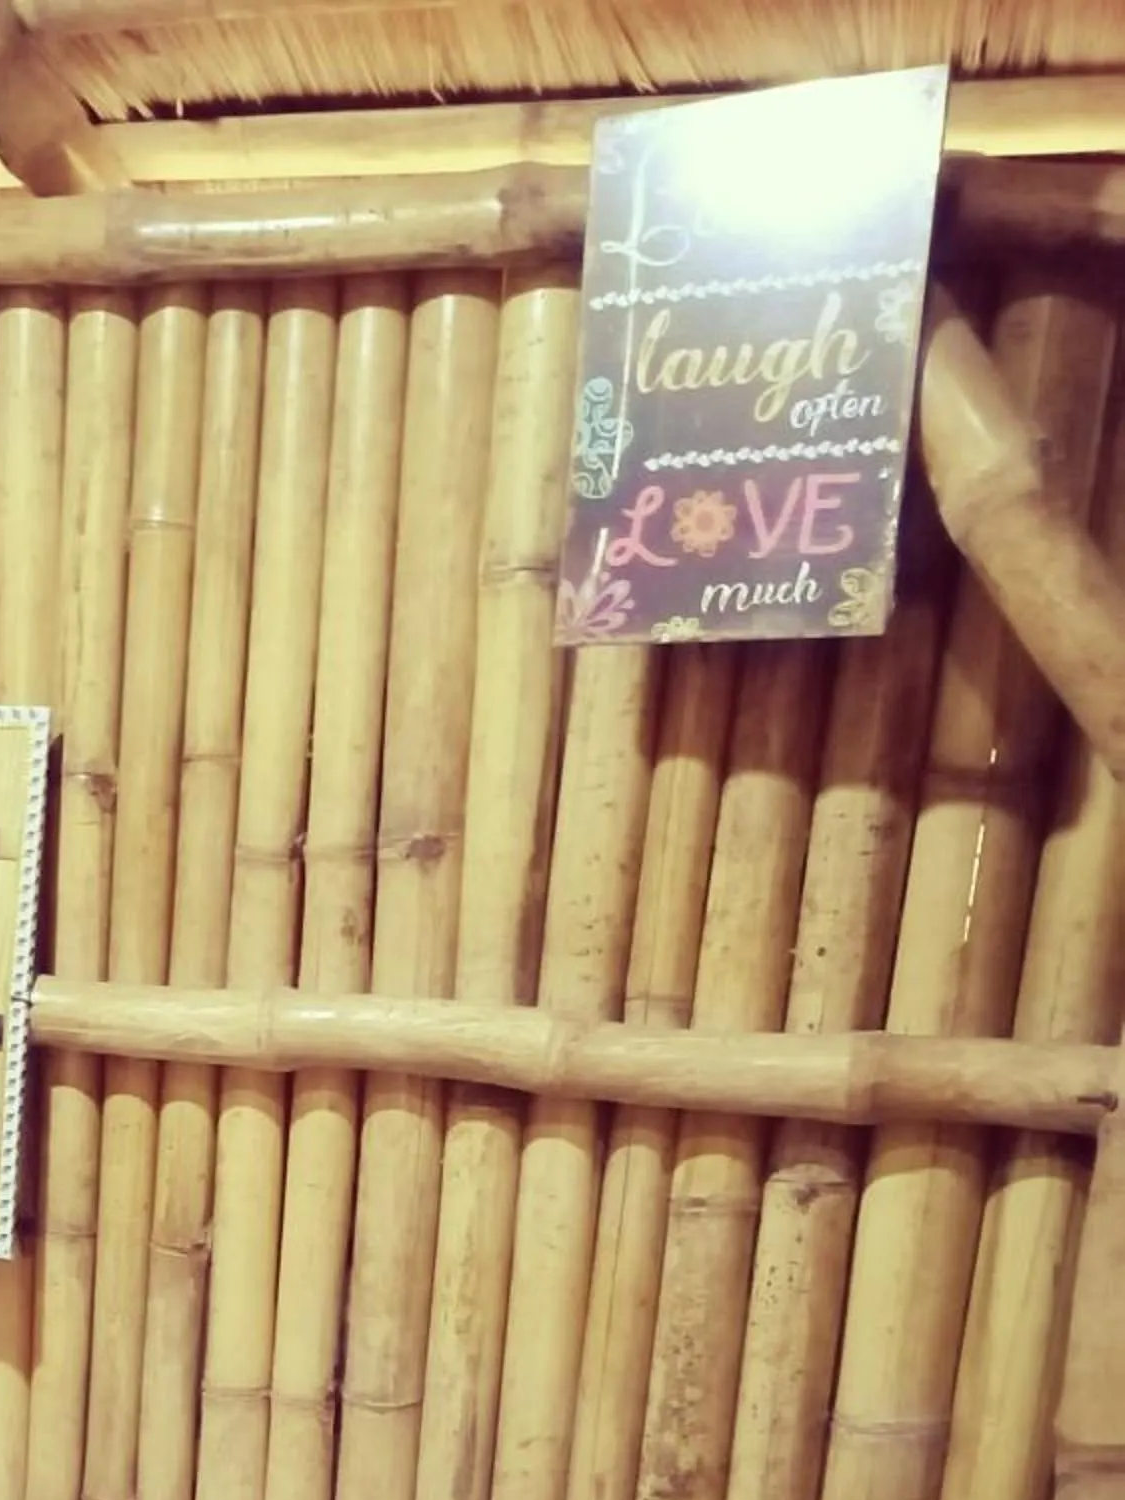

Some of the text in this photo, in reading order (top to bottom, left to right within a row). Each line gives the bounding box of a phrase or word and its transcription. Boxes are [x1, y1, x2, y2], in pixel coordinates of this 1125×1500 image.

[636, 290, 870, 423] laugh
[789, 378, 884, 437] often
[700, 560, 823, 613] much
